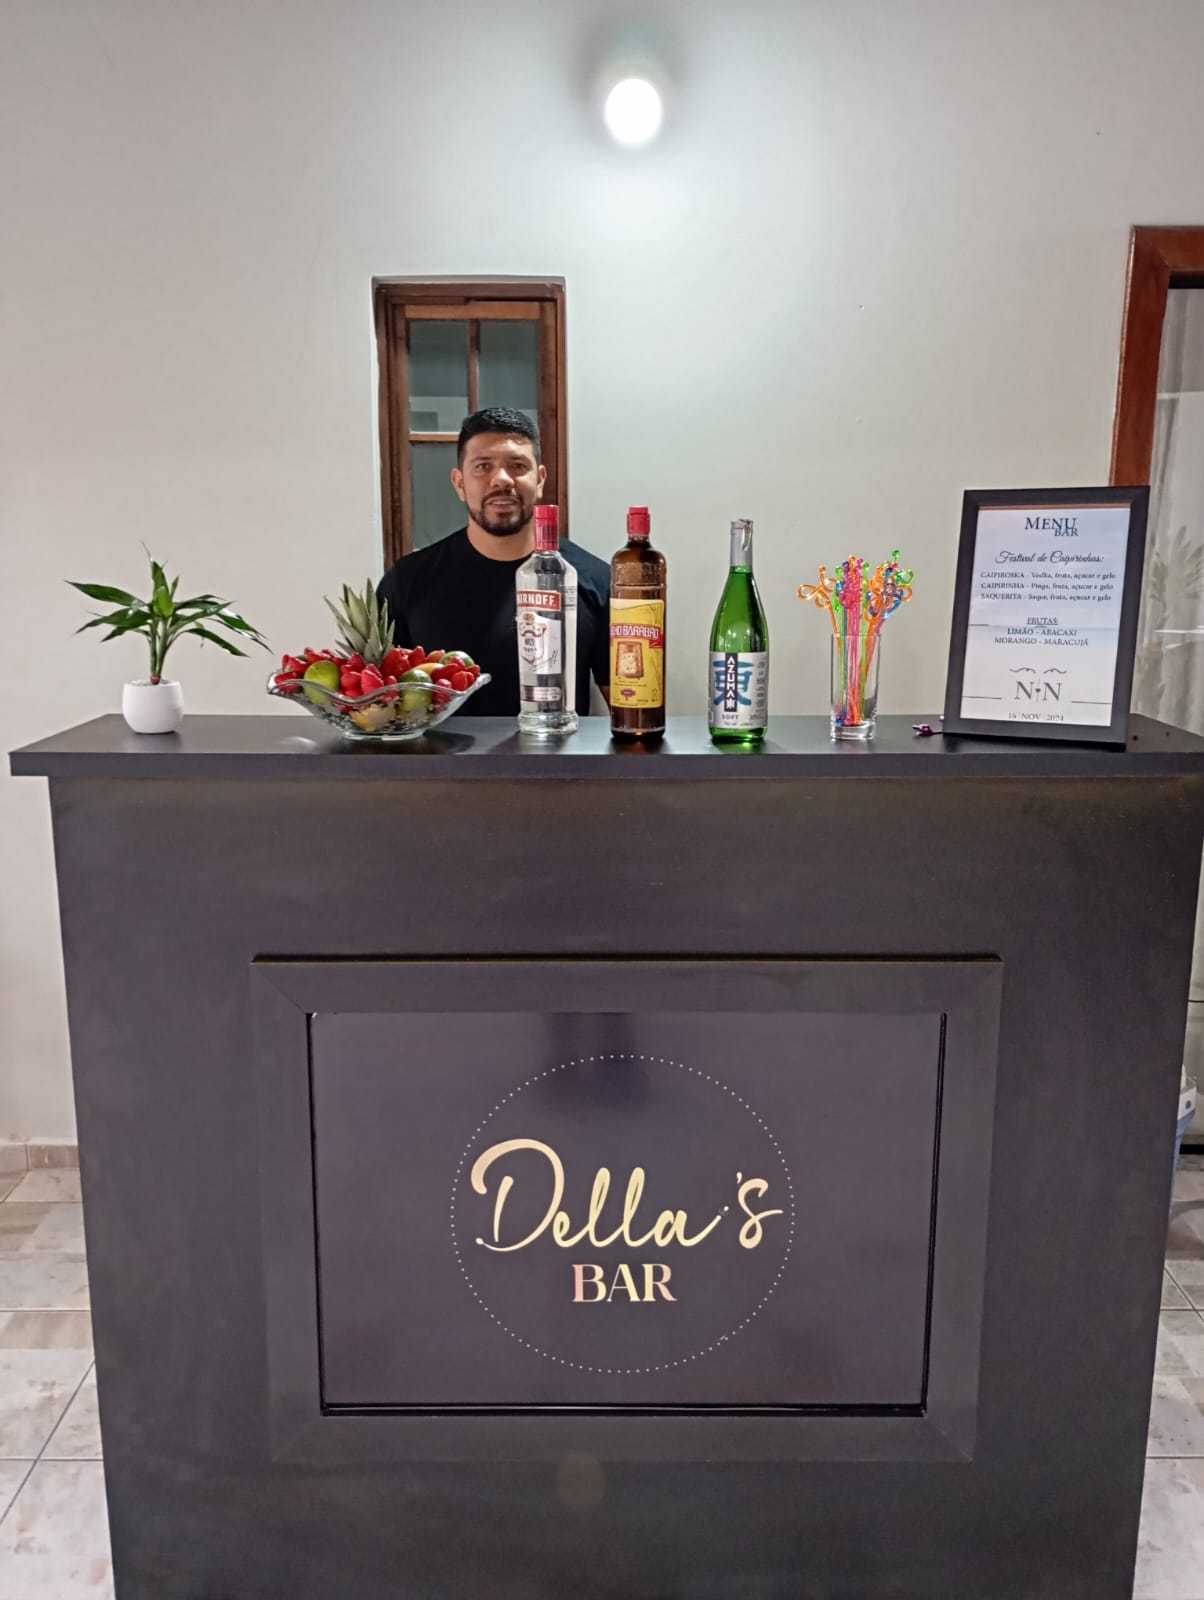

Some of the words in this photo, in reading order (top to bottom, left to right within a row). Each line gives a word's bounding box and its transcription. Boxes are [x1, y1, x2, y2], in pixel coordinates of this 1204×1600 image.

[1025, 517, 1077, 530] MENU
[1055, 528, 1079, 537] BAR
[995, 550, 1036, 564] Festival
[1037, 553, 1047, 562] de
[1101, 572, 1116, 580] gelo
[1031, 583, 1051, 591] Pinga,
[980, 593, 1022, 601] SAQUERITA
[1098, 594, 1112, 602] gelo
[1026, 616, 1058, 625] FRUTAS
[1007, 627, 1034, 635] LIMÃO
[1040, 628, 1078, 636] ABACAXI
[994, 636, 1038, 645] MORANGO
[1043, 638, 1089, 646] MARACUJÁ
[727, 656, 735, 698] AZUMA
[1013, 681, 1035, 700] N
[1041, 682, 1063, 701] N
[1021, 712, 1042, 720] NOV
[470, 1138, 784, 1252] Della's
[571, 1263, 677, 1303] BAR
